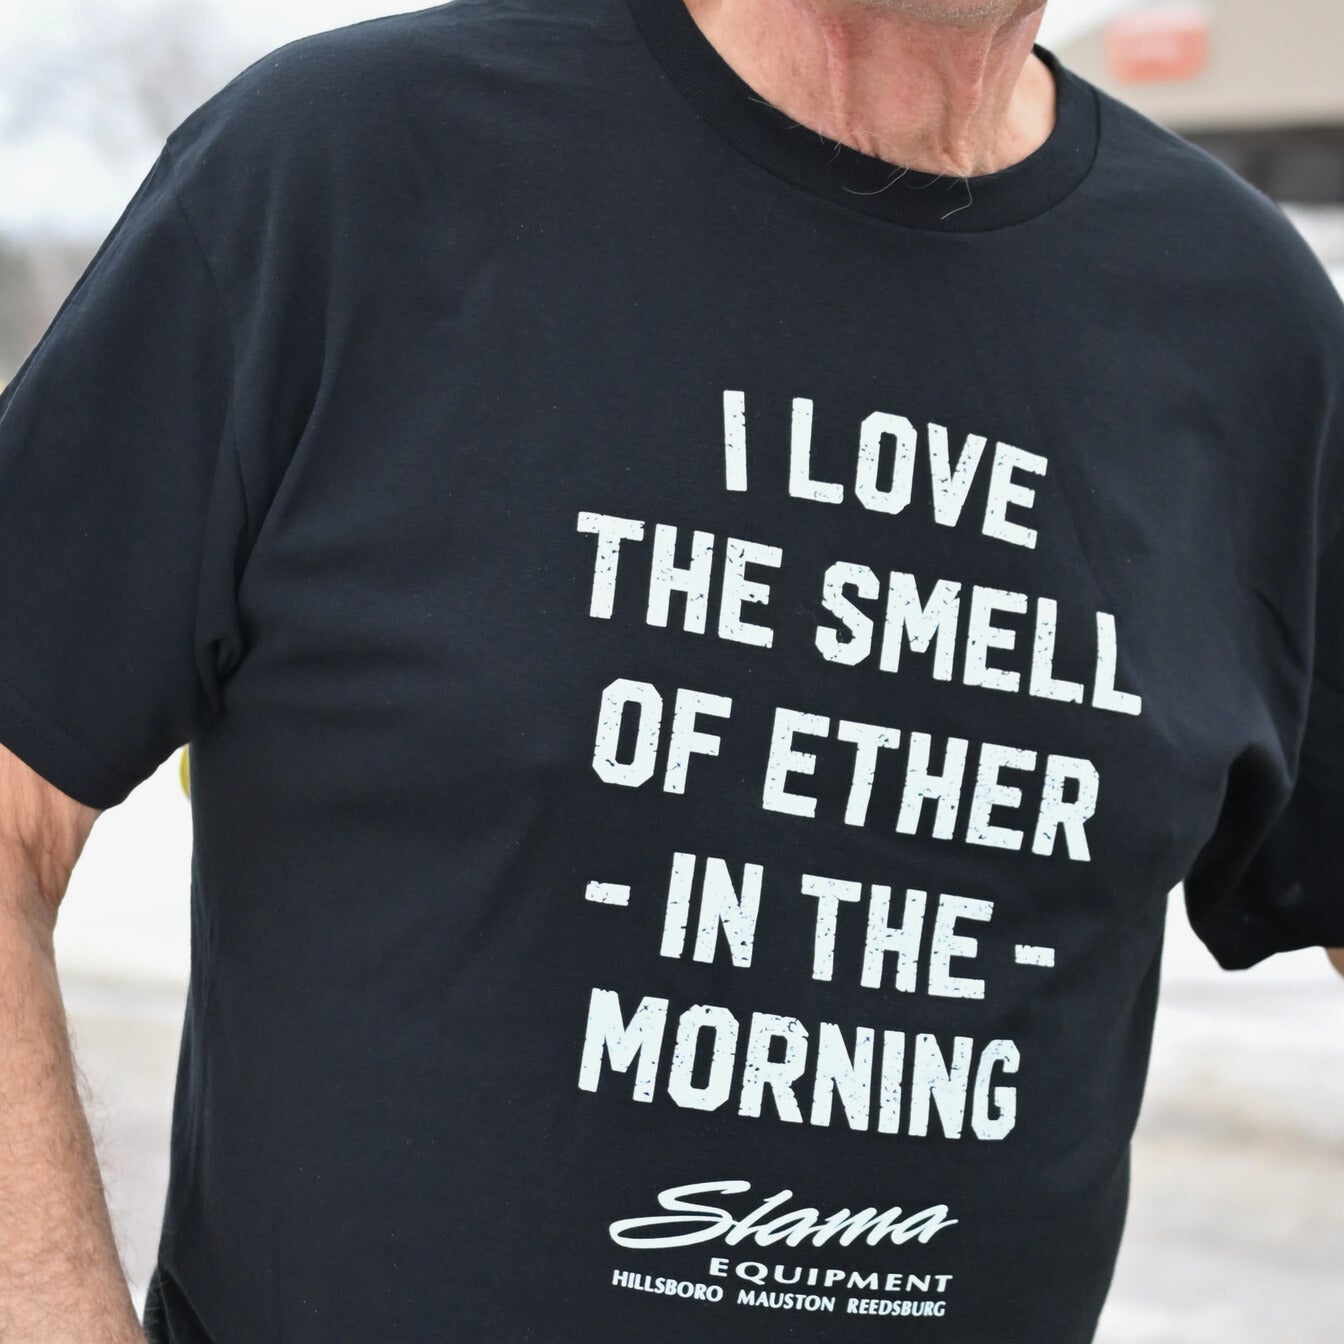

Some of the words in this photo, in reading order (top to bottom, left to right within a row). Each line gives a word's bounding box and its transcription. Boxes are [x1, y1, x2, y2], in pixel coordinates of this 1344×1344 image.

[723, 390, 747, 492] I
[789, 397, 1048, 549] LOVE
[577, 511, 782, 648] THE
[815, 561, 1142, 716] SMELL
[592, 678, 732, 794] OF
[763, 707, 1099, 862] ETHER
[660, 852, 763, 968] IN
[801, 874, 994, 999] THE
[578, 988, 1021, 1140] MORNING
[609, 1180, 958, 1249] Slama
[709, 1258, 953, 1293] EQUIPMENT
[612, 1269, 724, 1303] HILLSBORO
[737, 1289, 835, 1313] MAUSTON
[847, 1298, 946, 1317] REEDSBURG
